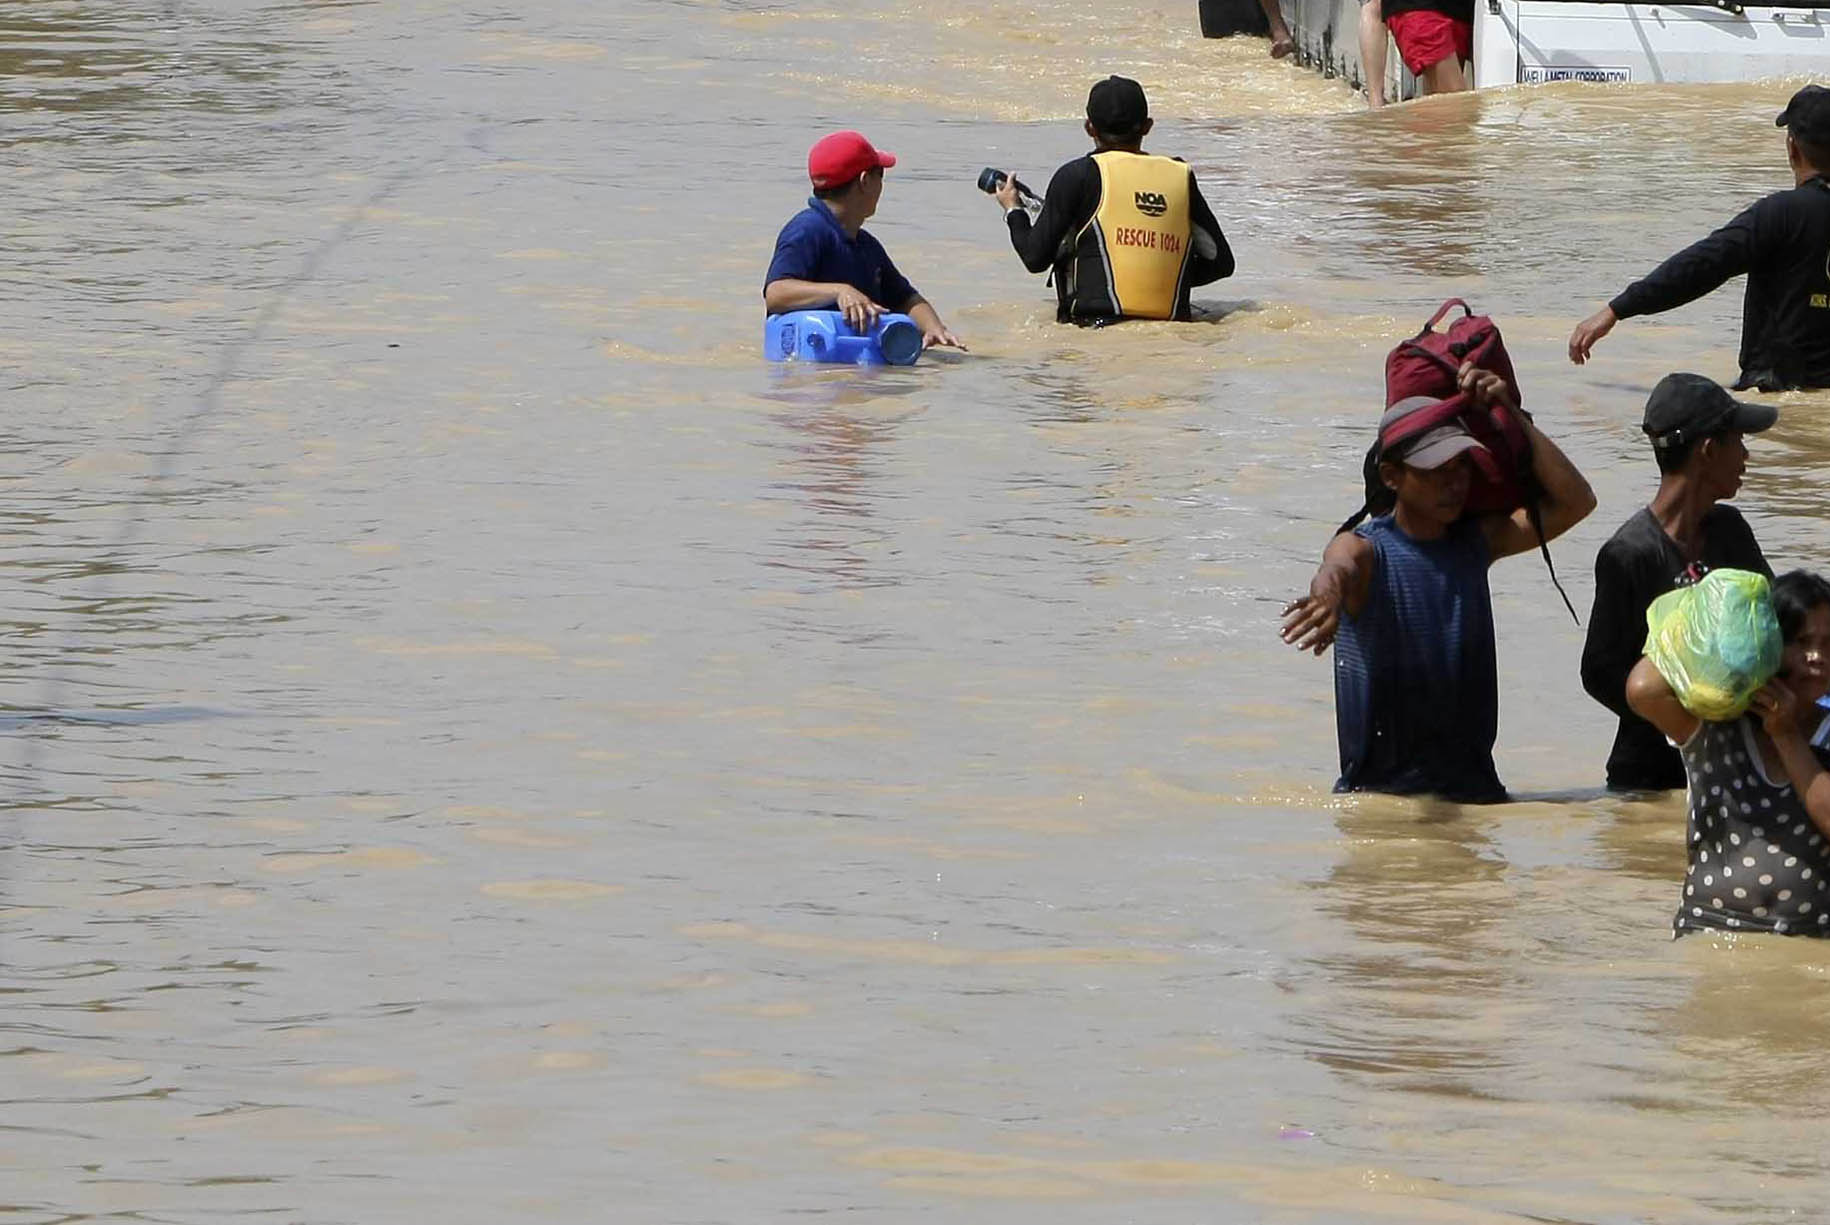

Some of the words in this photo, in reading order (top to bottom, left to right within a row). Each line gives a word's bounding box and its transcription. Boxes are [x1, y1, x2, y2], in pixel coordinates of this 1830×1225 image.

[1134, 191, 1167, 206] NOA
[1115, 227, 1156, 249] RESCUE
[1160, 232, 1181, 254] 1024
